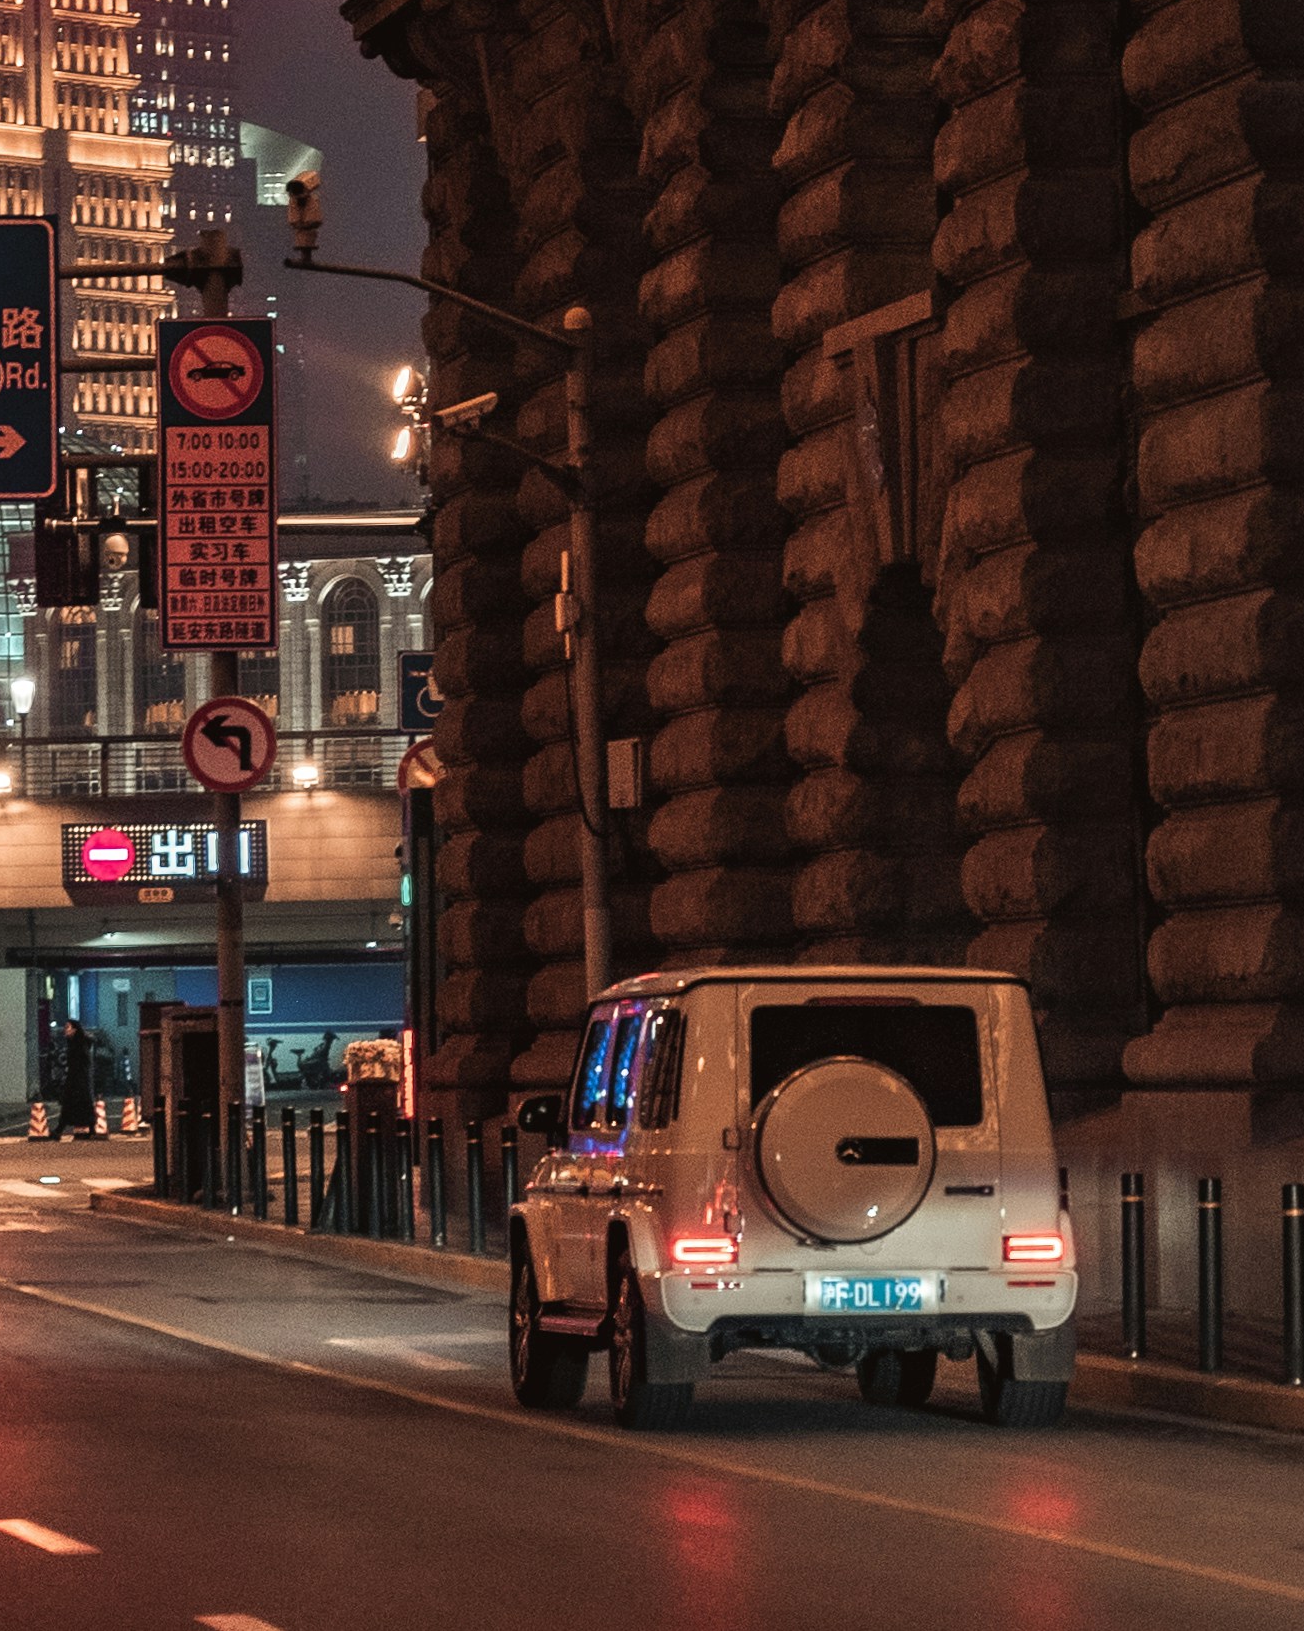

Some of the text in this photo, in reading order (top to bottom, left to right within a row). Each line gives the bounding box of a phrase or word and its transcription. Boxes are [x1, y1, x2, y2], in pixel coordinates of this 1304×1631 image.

[170, 461, 266, 479] 15:00-20:00
[171, 489, 266, 509] 外省市号牌
[178, 516, 259, 535] 出租空车
[189, 542, 251, 561] 实习车
[179, 568, 259, 588] 临时号牌
[170, 621, 267, 641] 延安东路隧道
